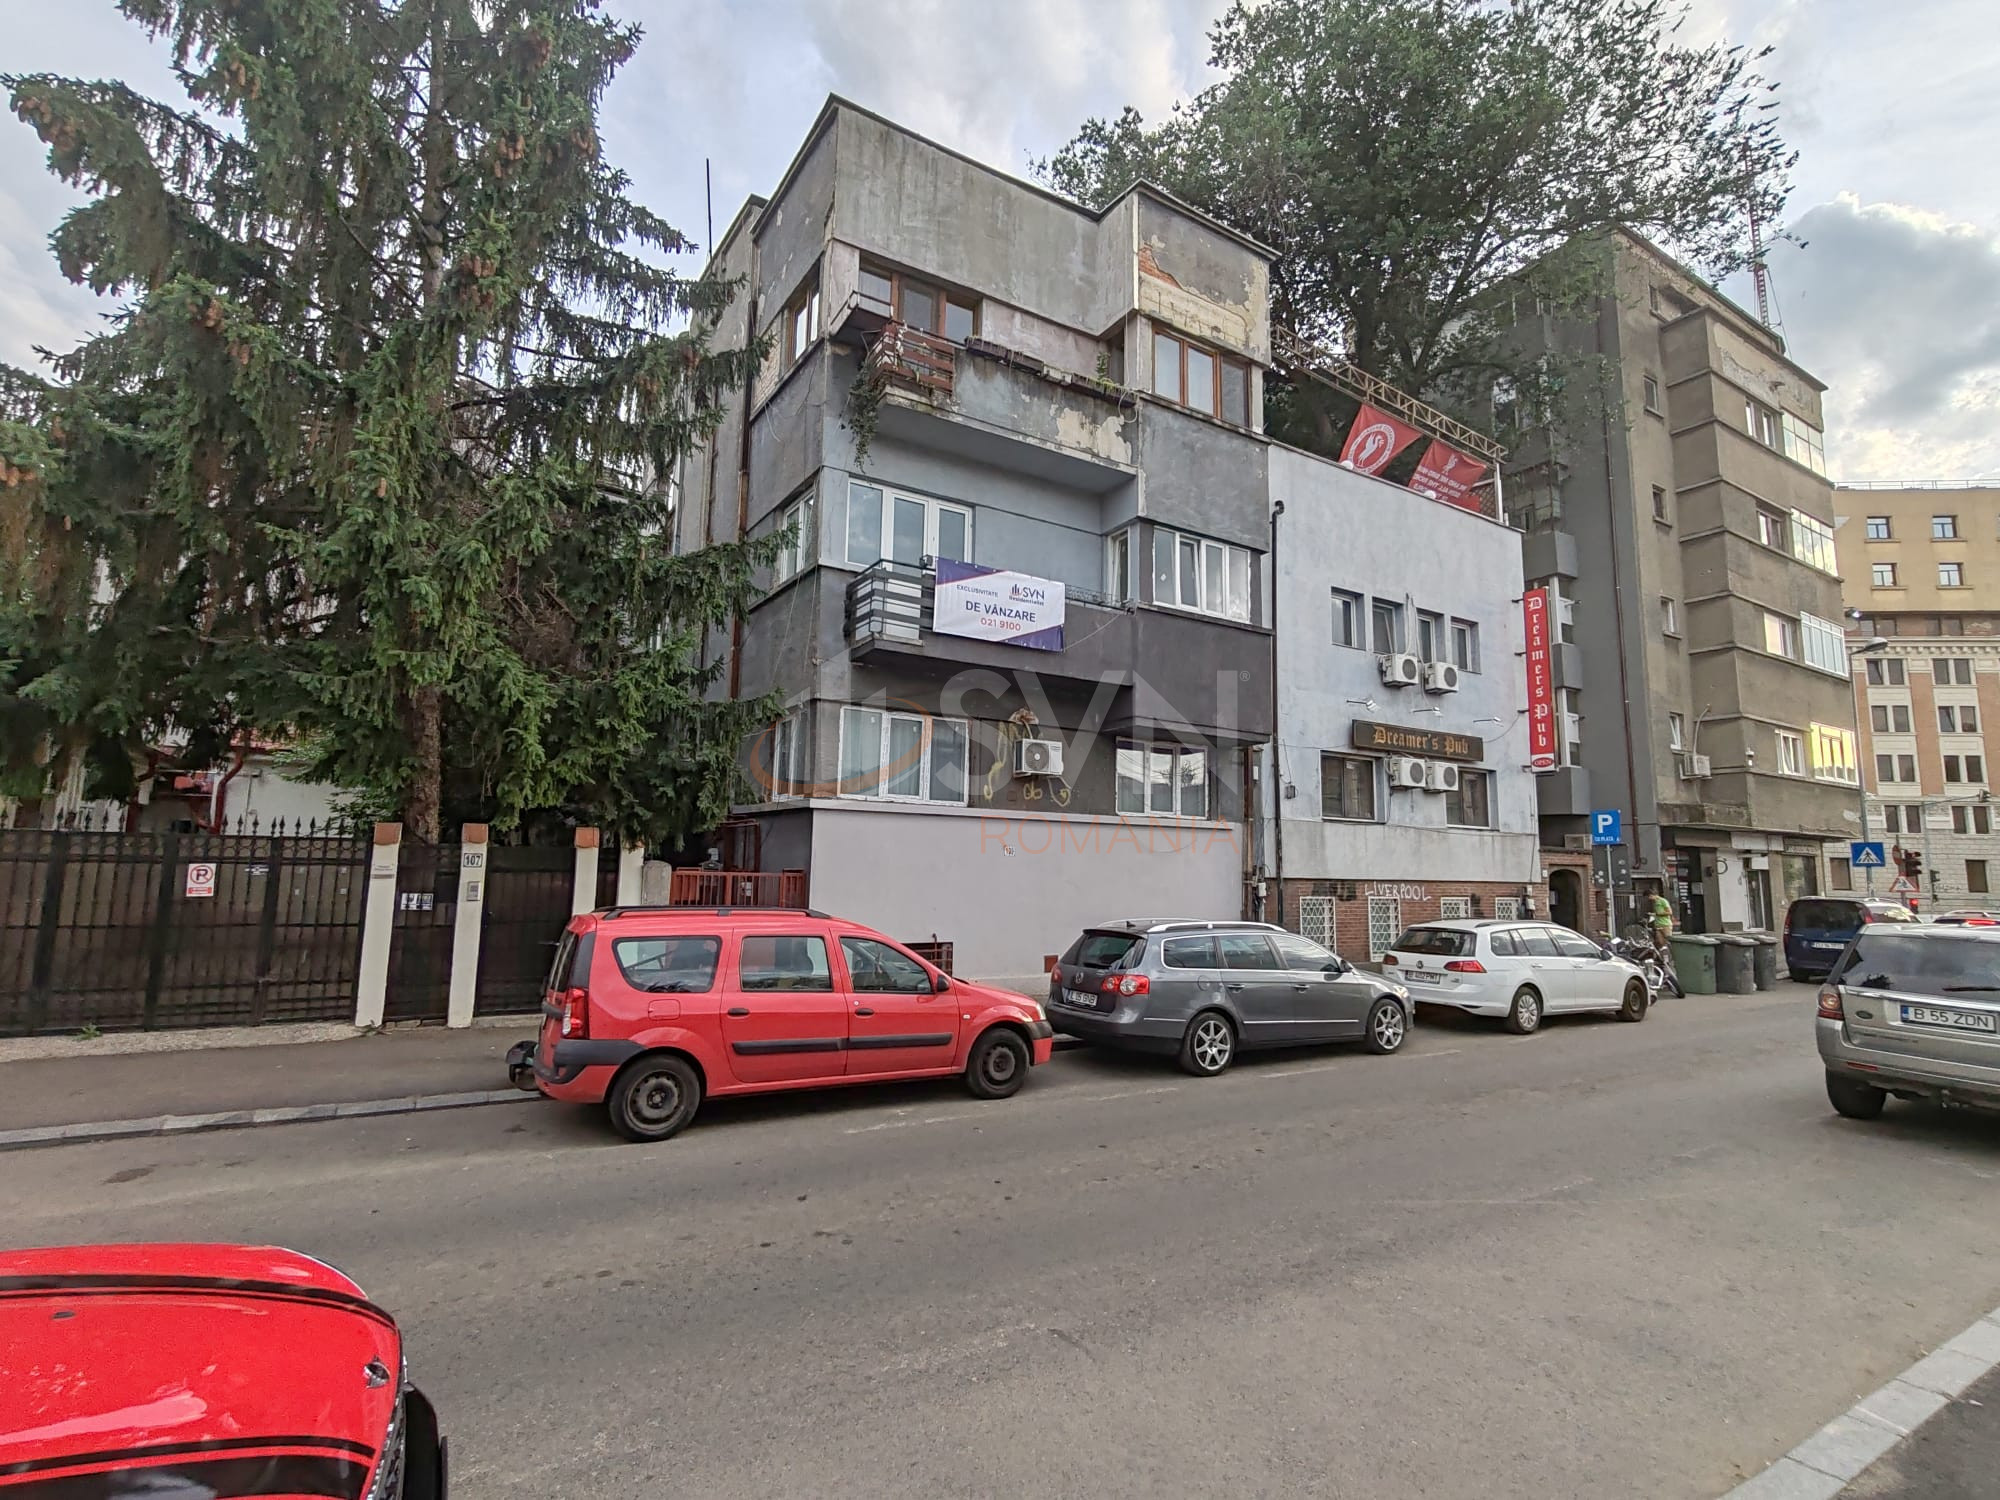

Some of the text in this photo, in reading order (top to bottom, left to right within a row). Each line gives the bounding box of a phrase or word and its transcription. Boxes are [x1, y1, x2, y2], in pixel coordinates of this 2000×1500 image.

[956, 584, 999, 598] EXCLUSIVITATE
[1022, 587, 1045, 601] SVN
[965, 600, 981, 613] DE
[980, 617, 1021, 632] 021 9100
[1527, 595, 1544, 698] Dreamers
[1534, 703, 1548, 748] Pub
[1373, 725, 1469, 755] Dreamer's Pub
[1597, 814, 1613, 834] P
[465, 855, 481, 866] 107
[1914, 1008, 1989, 1028] B 55 ZDN
